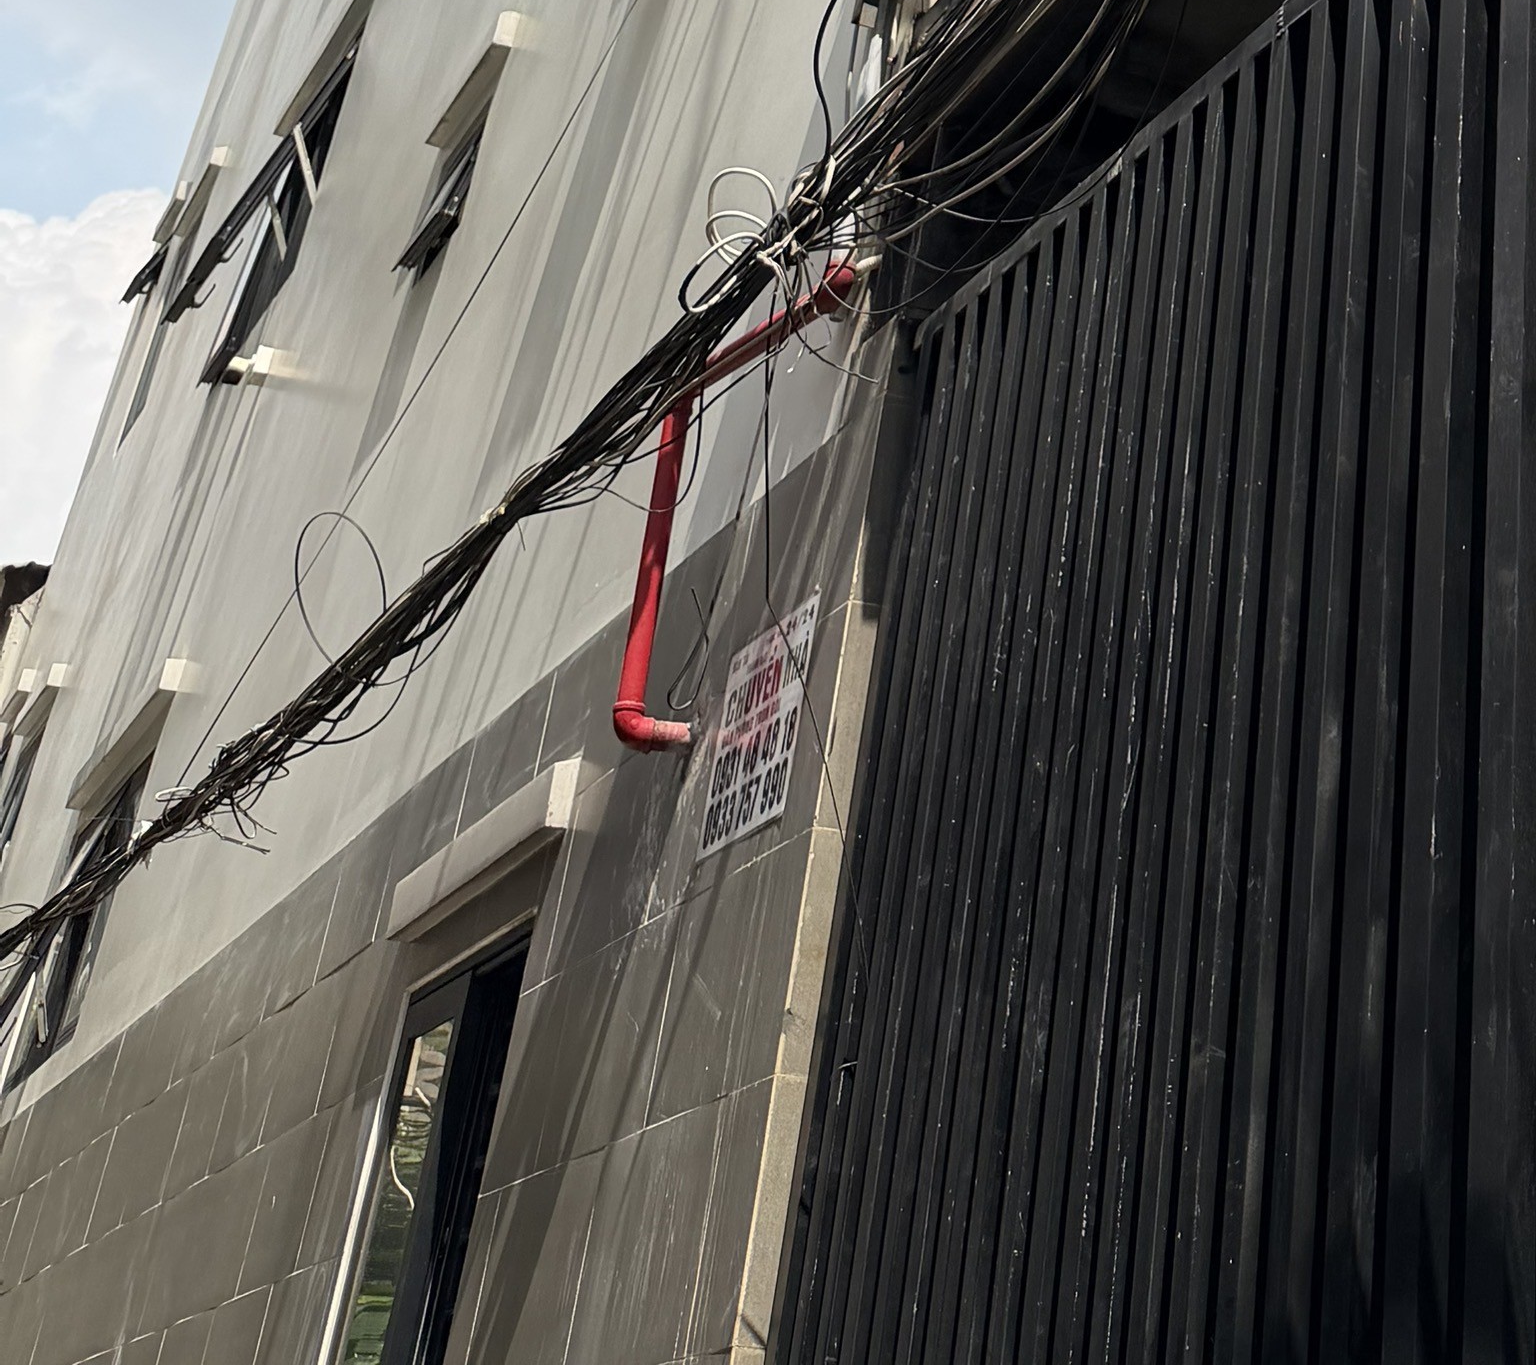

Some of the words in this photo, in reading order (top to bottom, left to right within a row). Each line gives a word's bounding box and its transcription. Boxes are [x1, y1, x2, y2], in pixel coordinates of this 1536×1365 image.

[725, 645, 784, 728] CHUYỂN
[711, 742, 743, 800] 0931
[780, 705, 799, 754] 18
[702, 789, 737, 850] 0933
[734, 773, 762, 831] 757
[759, 756, 789, 816] 990
